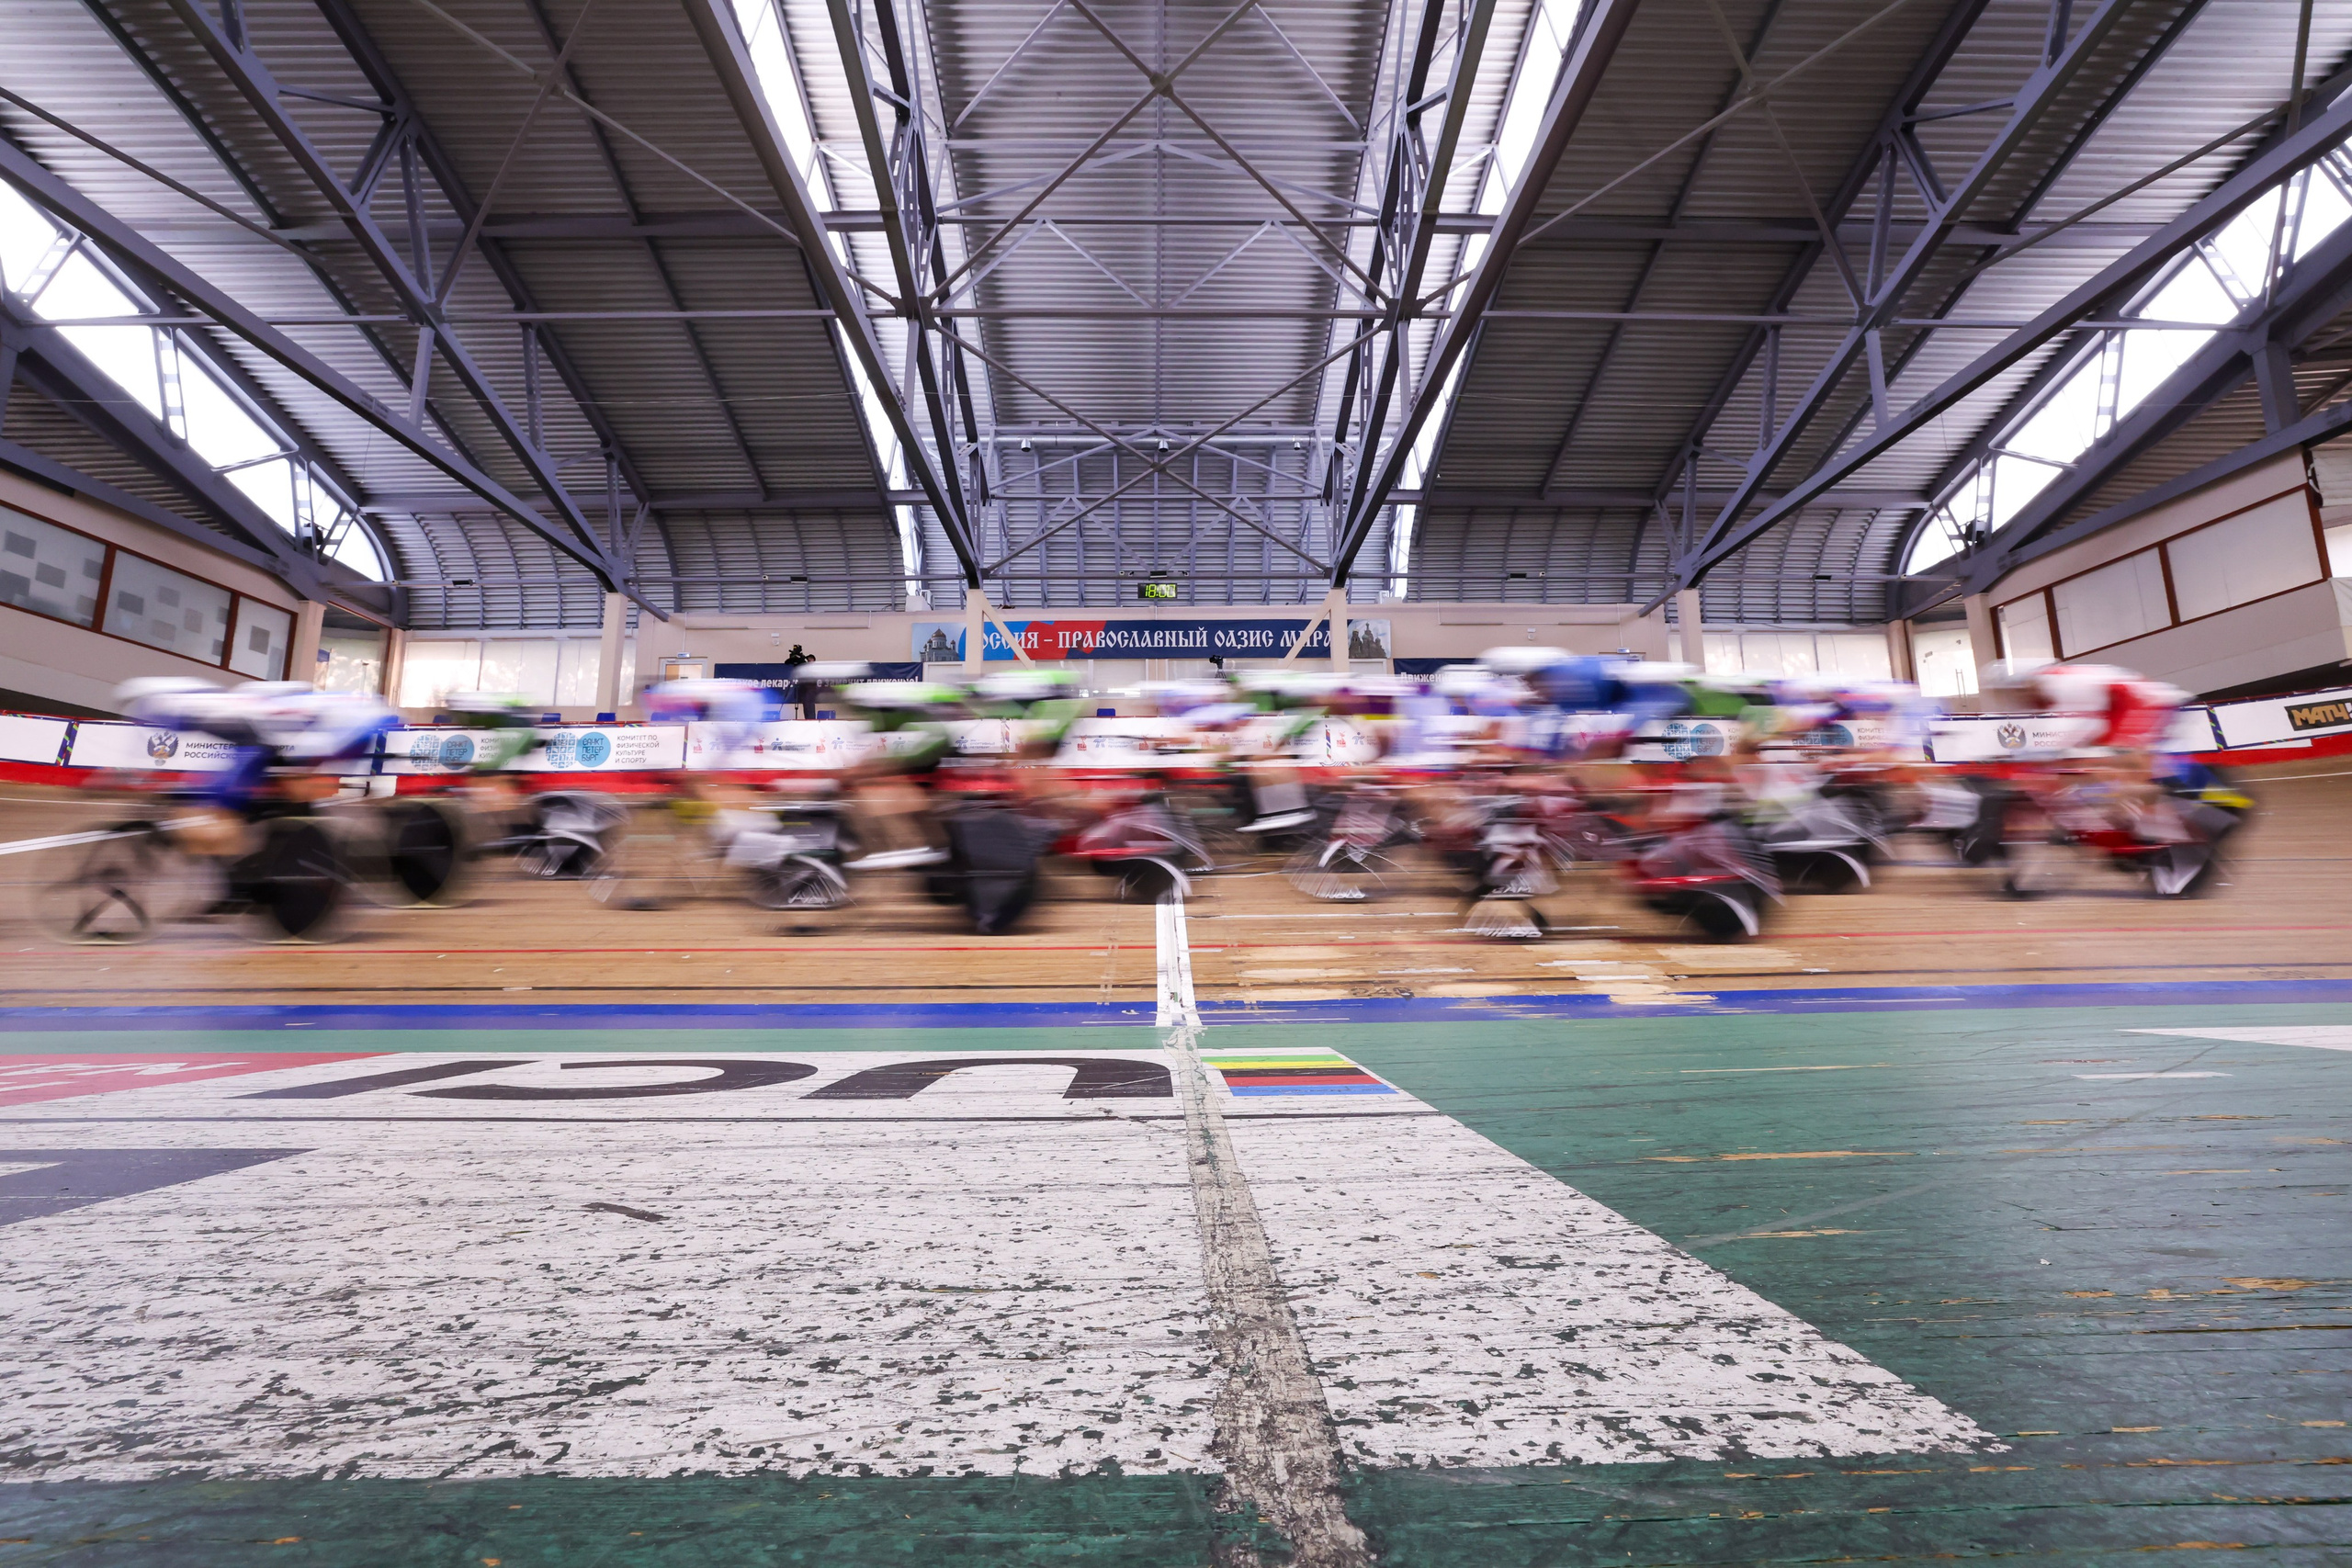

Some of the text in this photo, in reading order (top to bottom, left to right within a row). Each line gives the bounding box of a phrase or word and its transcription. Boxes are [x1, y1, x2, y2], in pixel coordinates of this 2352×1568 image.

[983, 631, 1039, 649] ОССИЯ
[1057, 626, 1208, 649] ПРАВОСЛАВНЫЙ
[1214, 629, 1274, 649] ОАЗИС
[186, 742, 236, 750] МИНИСТЕР
[616, 740, 660, 749] ФИЗИЧЕСКОЙ
[582, 746, 605, 754] ПЕТЕР
[184, 750, 237, 760] РОССИЙСКО
[582, 753, 599, 762] БУРГ
[224, 1058, 1173, 1100] UCI
